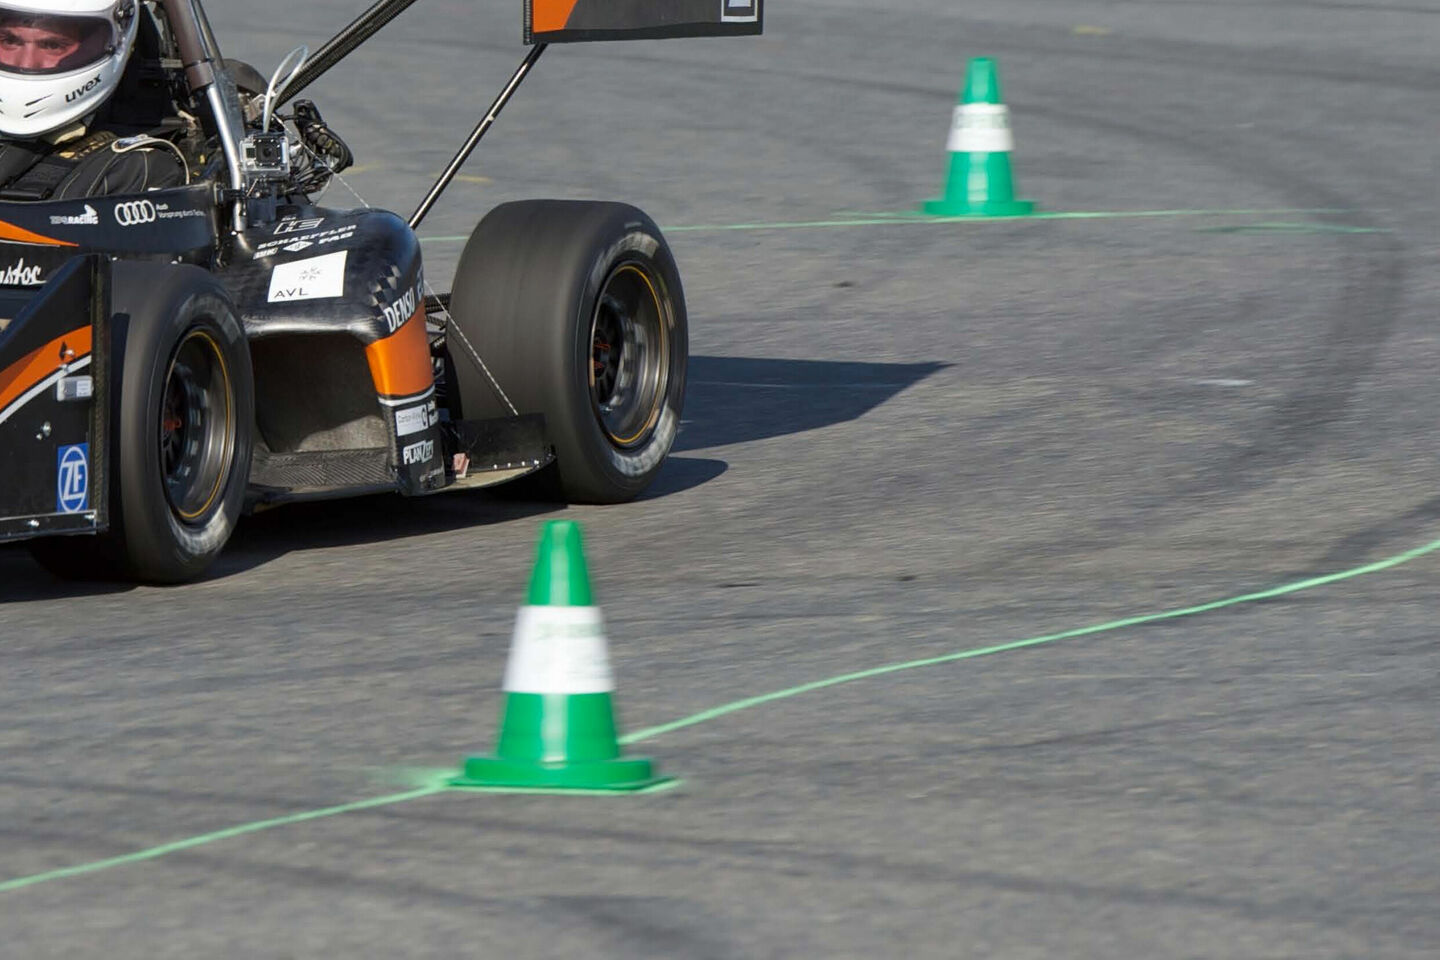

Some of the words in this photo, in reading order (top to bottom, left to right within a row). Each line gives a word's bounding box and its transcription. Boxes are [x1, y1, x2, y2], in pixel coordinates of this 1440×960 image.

[65, 74, 101, 103] uvex
[274, 287, 309, 298] AVL
[383, 287, 416, 333] DENSO
[62, 460, 85, 501] ZF
